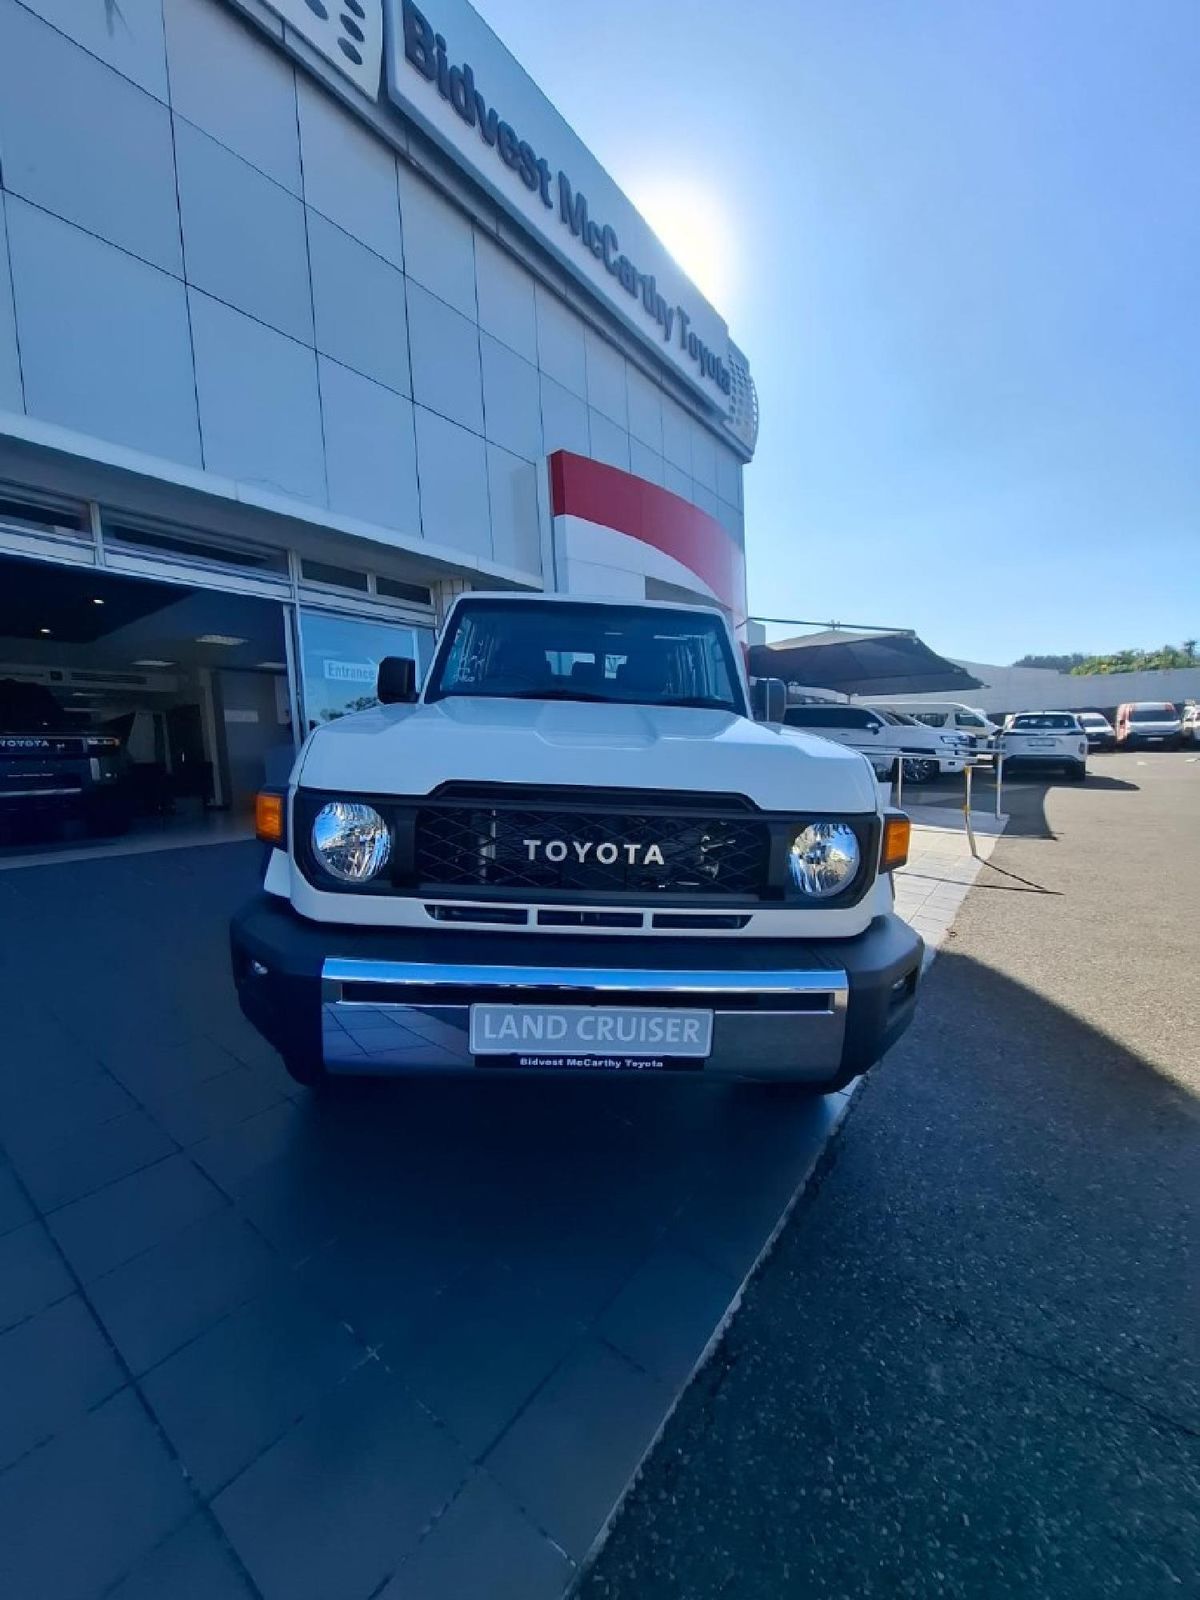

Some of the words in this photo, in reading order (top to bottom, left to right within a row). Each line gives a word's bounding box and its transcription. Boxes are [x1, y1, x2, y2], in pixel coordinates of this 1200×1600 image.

[402, 0, 553, 210] Bidvest
[558, 170, 674, 342] McCarthy
[677, 305, 731, 396] Toyota
[328, 662, 376, 679] Entrance
[523, 839, 665, 865] TOYOTA
[484, 1014, 567, 1040] LAND
[576, 1015, 700, 1043] CRUISER
[520, 1057, 563, 1066] Bidvest
[566, 1058, 621, 1069] McCarthy
[625, 1059, 664, 1069] Toyota
